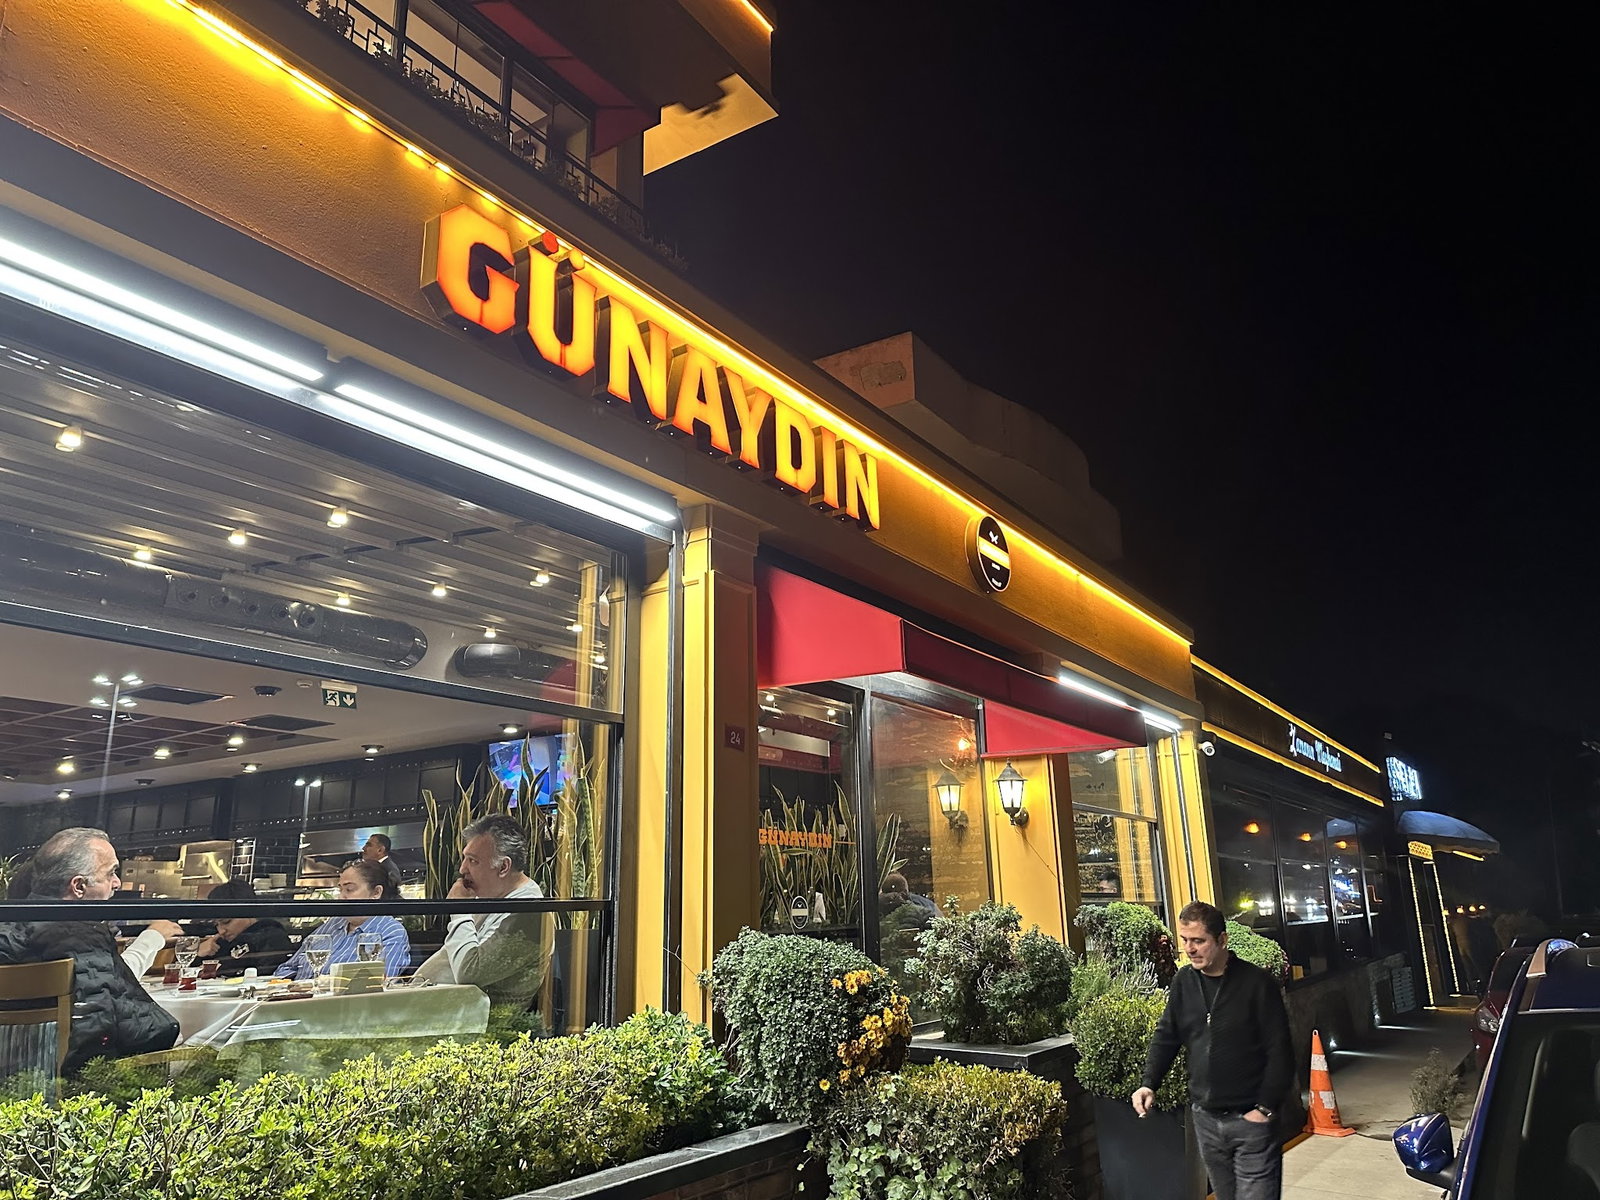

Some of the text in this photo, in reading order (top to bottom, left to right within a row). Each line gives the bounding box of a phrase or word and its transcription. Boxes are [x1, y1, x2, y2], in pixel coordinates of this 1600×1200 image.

[436, 203, 881, 531] GÜNAYDIN
[730, 731, 741, 745] 24
[758, 826, 832, 849] GÜNAYDIN
